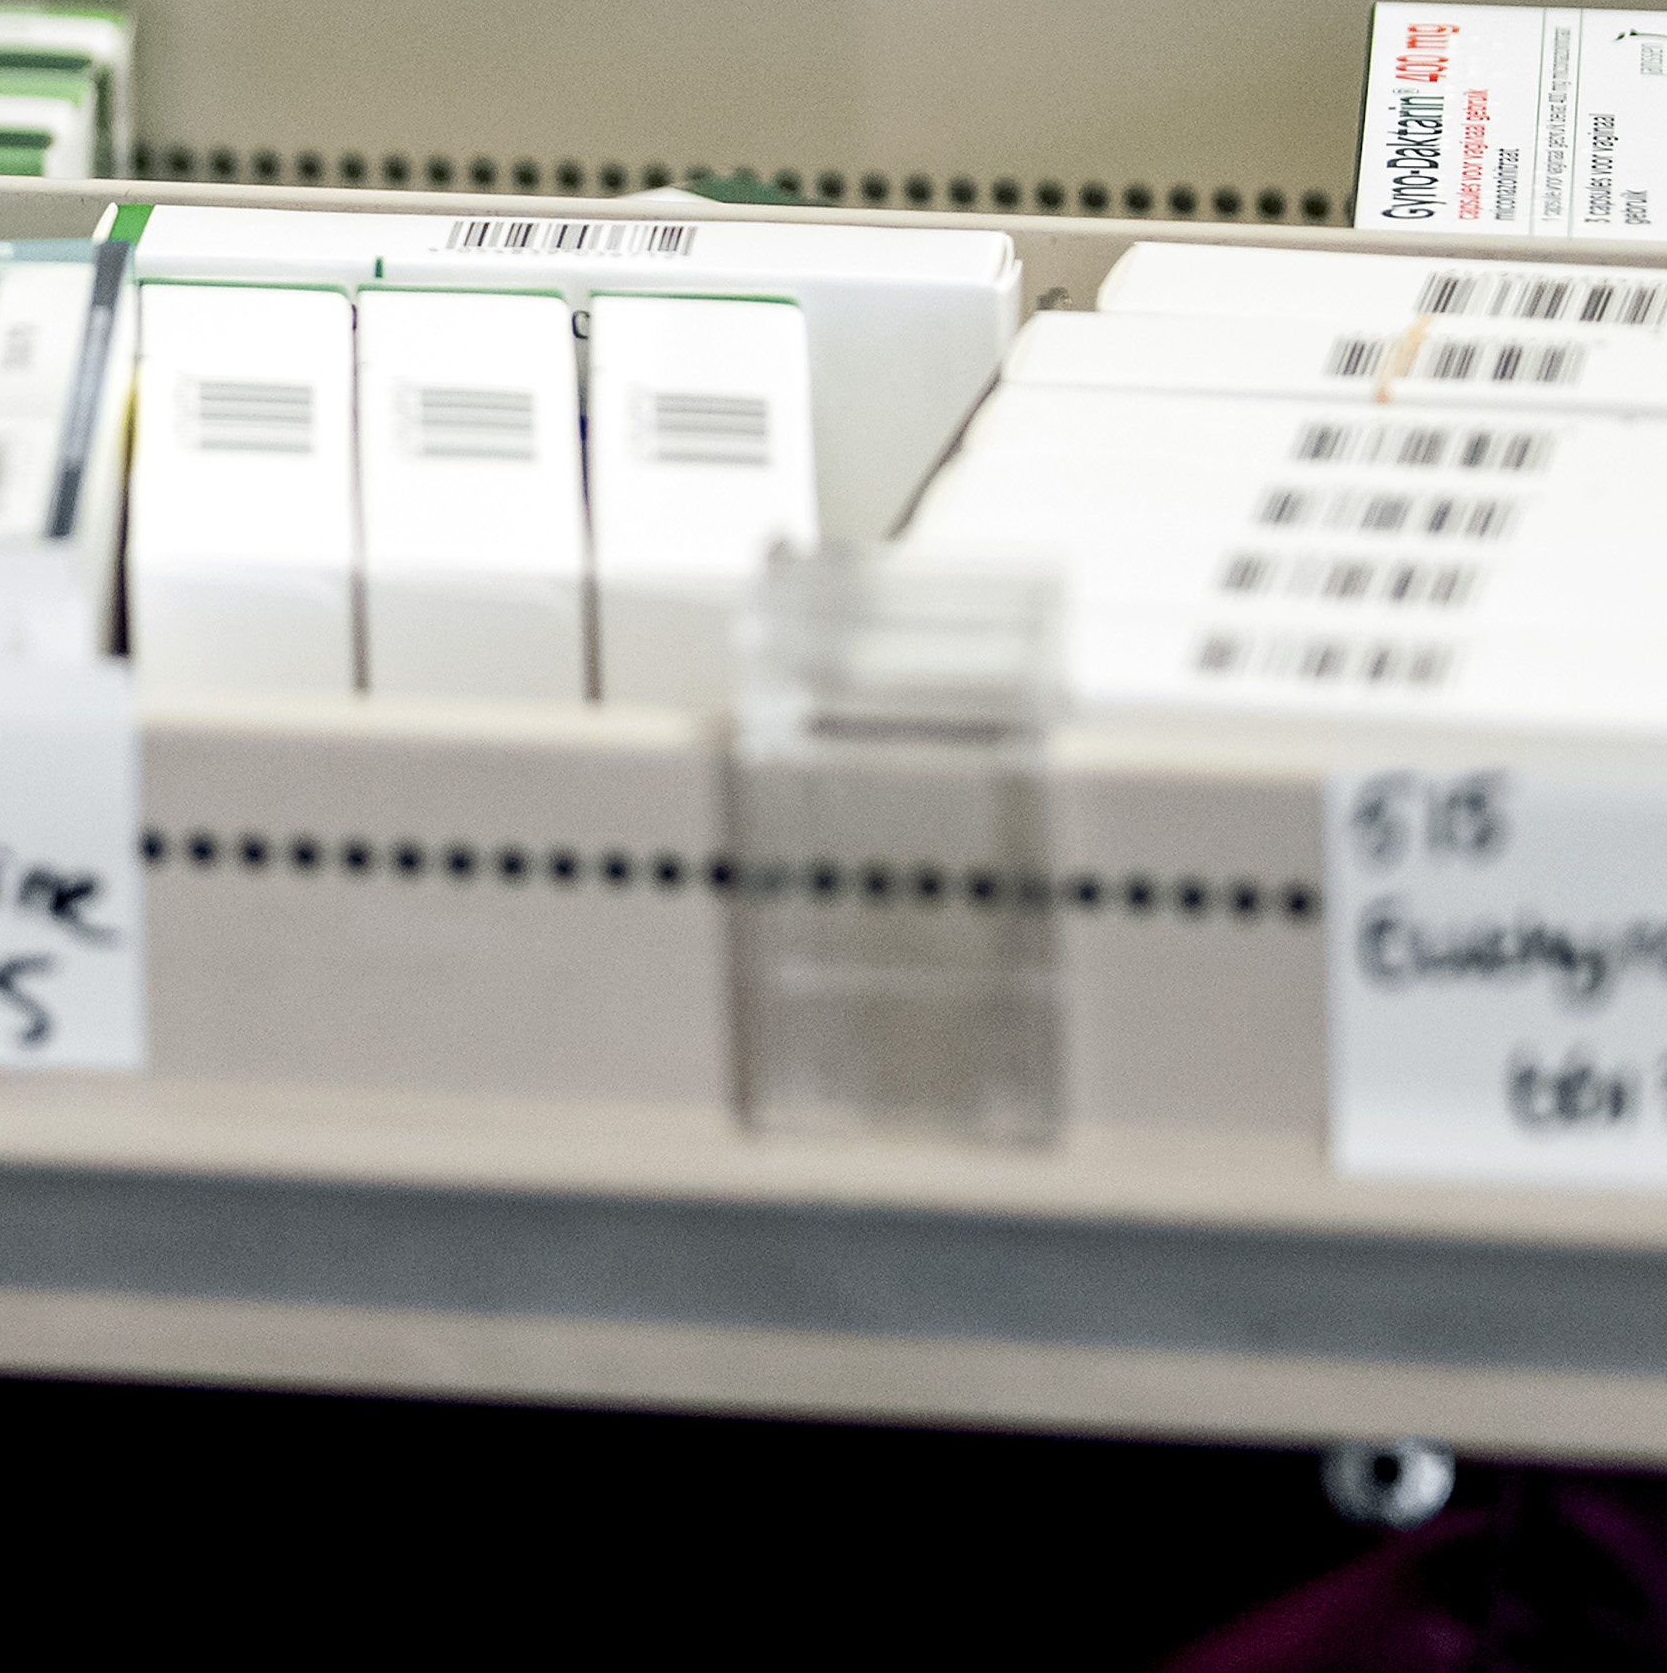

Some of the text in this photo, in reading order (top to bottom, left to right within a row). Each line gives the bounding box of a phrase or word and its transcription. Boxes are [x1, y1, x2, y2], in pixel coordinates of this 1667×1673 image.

[1406, 23, 1461, 49] mg
[1395, 54, 1449, 83] 400
[1587, 113, 1619, 153] vaginaal
[1458, 89, 1491, 220] capsules voor vaginaal gebruik
[1591, 154, 1614, 177] voor
[1585, 178, 1612, 217] capsules
[1620, 189, 1652, 225] gebruik
